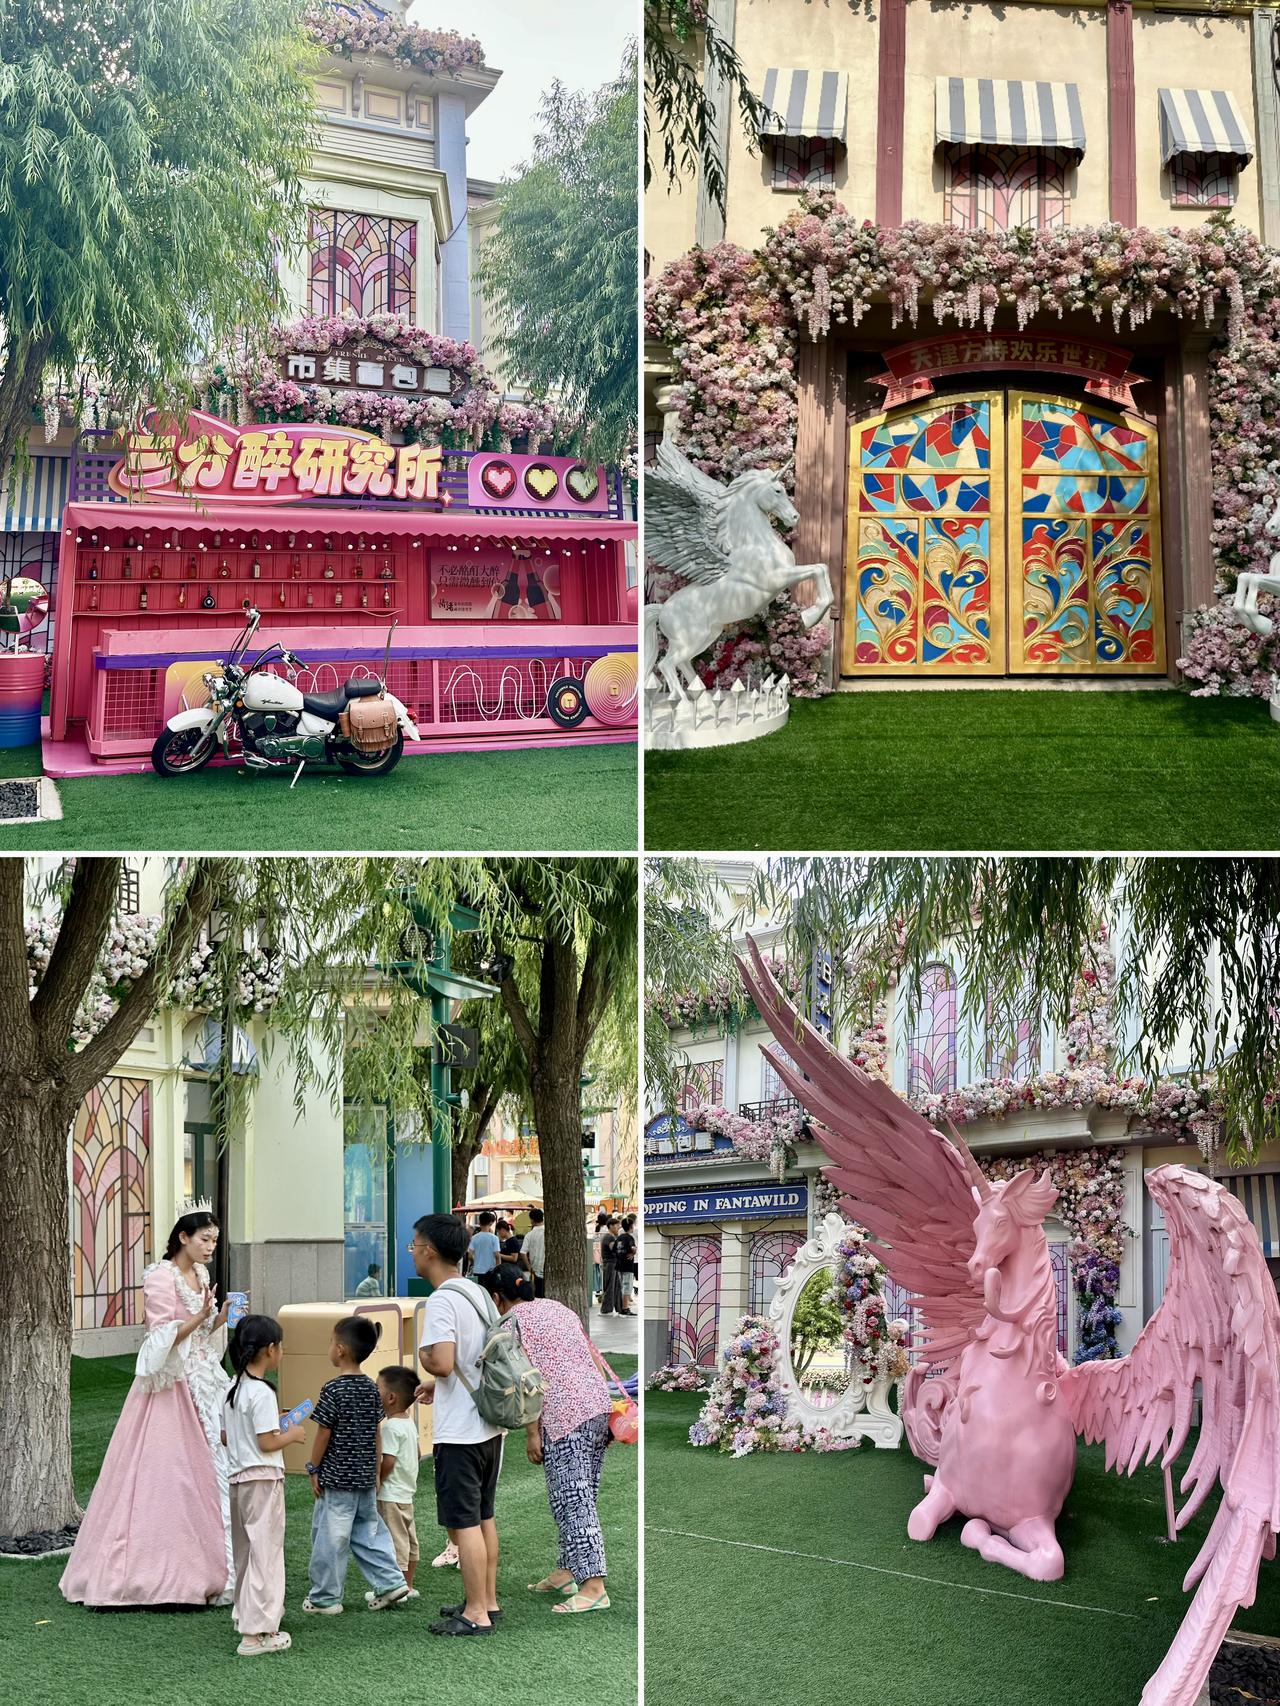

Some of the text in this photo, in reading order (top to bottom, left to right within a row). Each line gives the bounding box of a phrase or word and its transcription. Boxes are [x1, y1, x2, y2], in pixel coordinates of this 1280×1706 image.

[910, 338, 1108, 371] 天津方特欢乐世界
[287, 353, 453, 393] 市集面包屋
[119, 431, 443, 499] 三分醉研究所
[439, 564, 500, 577] 不必酩酊大醉
[693, 1199, 709, 1211] IN
[715, 1193, 800, 1210] FANTAWILD
